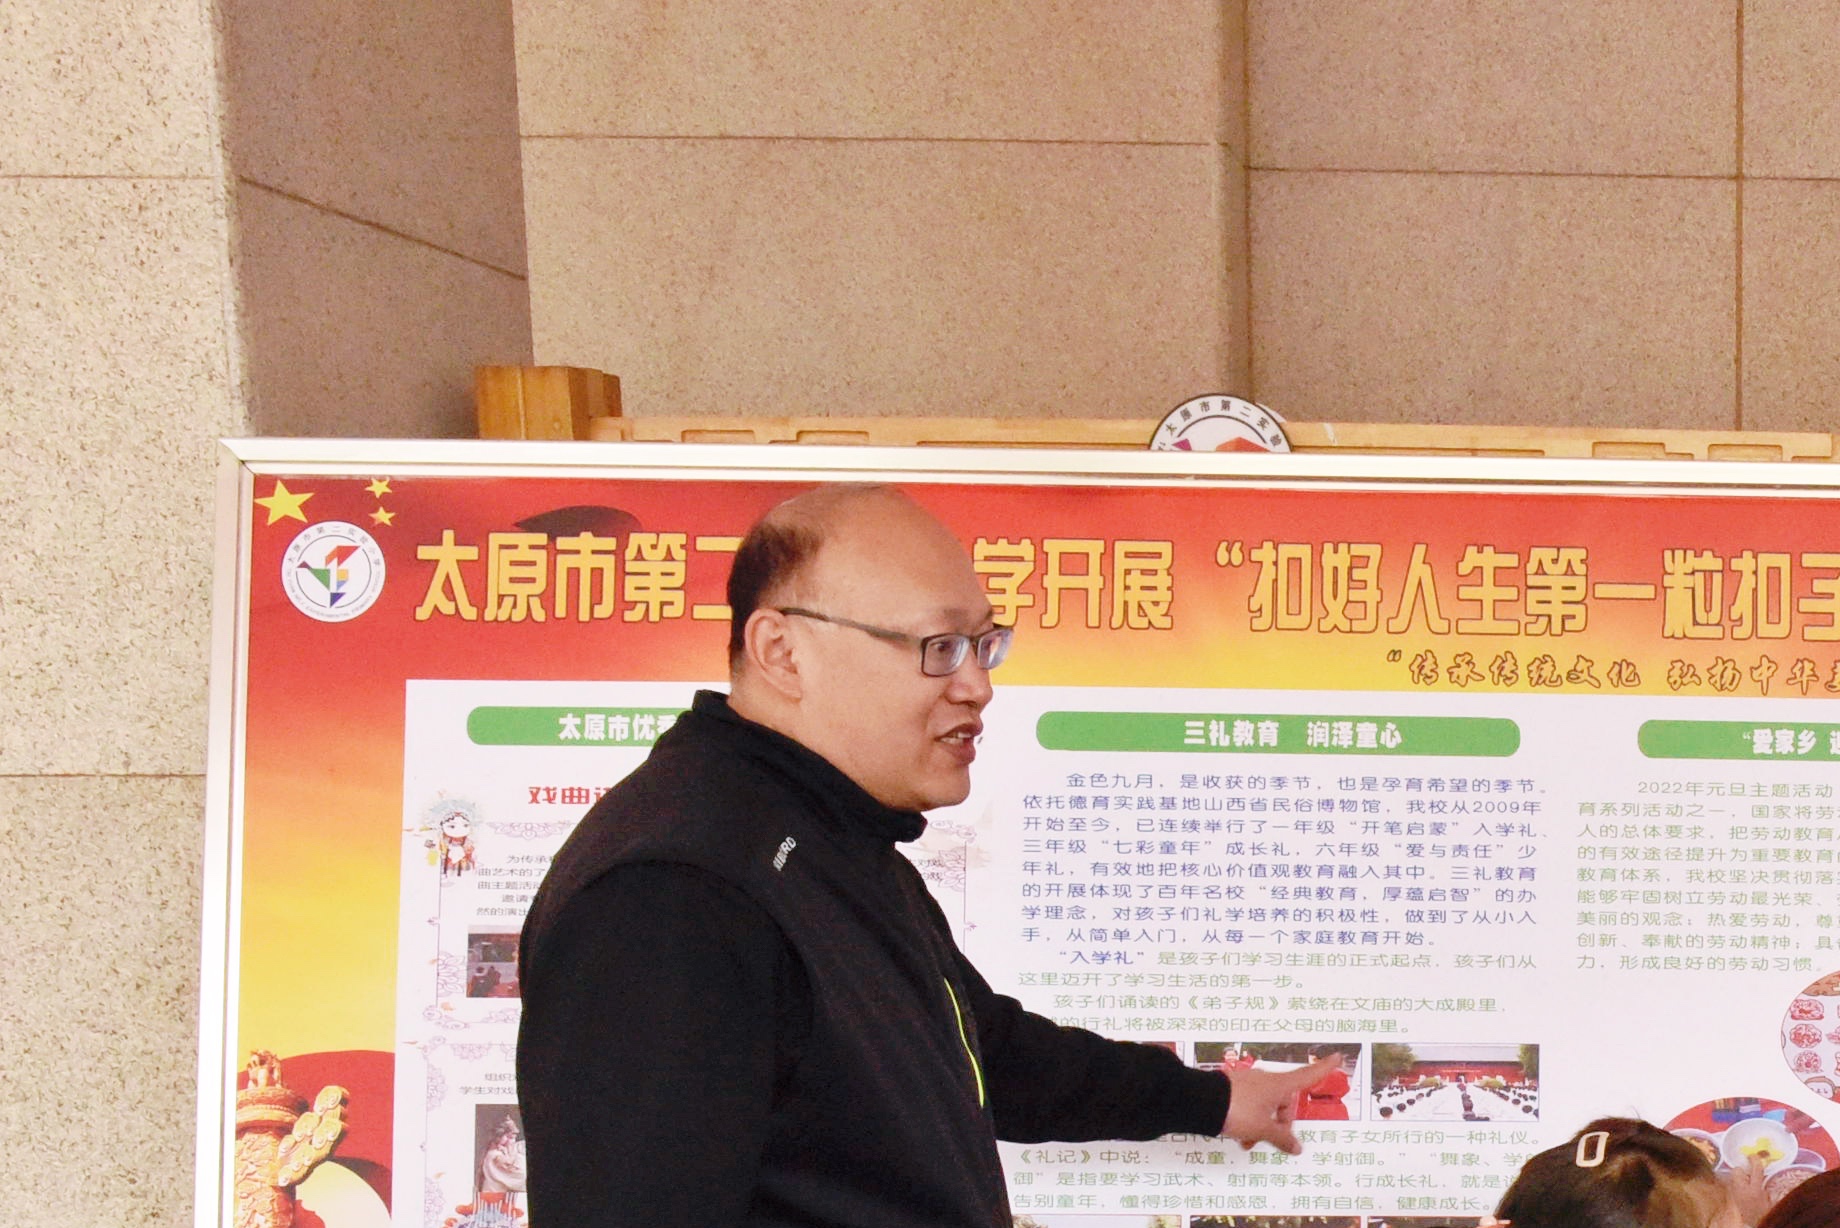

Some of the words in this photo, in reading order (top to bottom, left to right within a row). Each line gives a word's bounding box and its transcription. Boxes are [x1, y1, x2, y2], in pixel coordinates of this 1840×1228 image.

[1184, 719, 1280, 747] 三礼教育
[1306, 720, 1402, 749] 润泽童心
[1742, 728, 1817, 755] “爱家乡
[1018, 971, 1303, 989] 这里迈开了学习生活的第一步。
